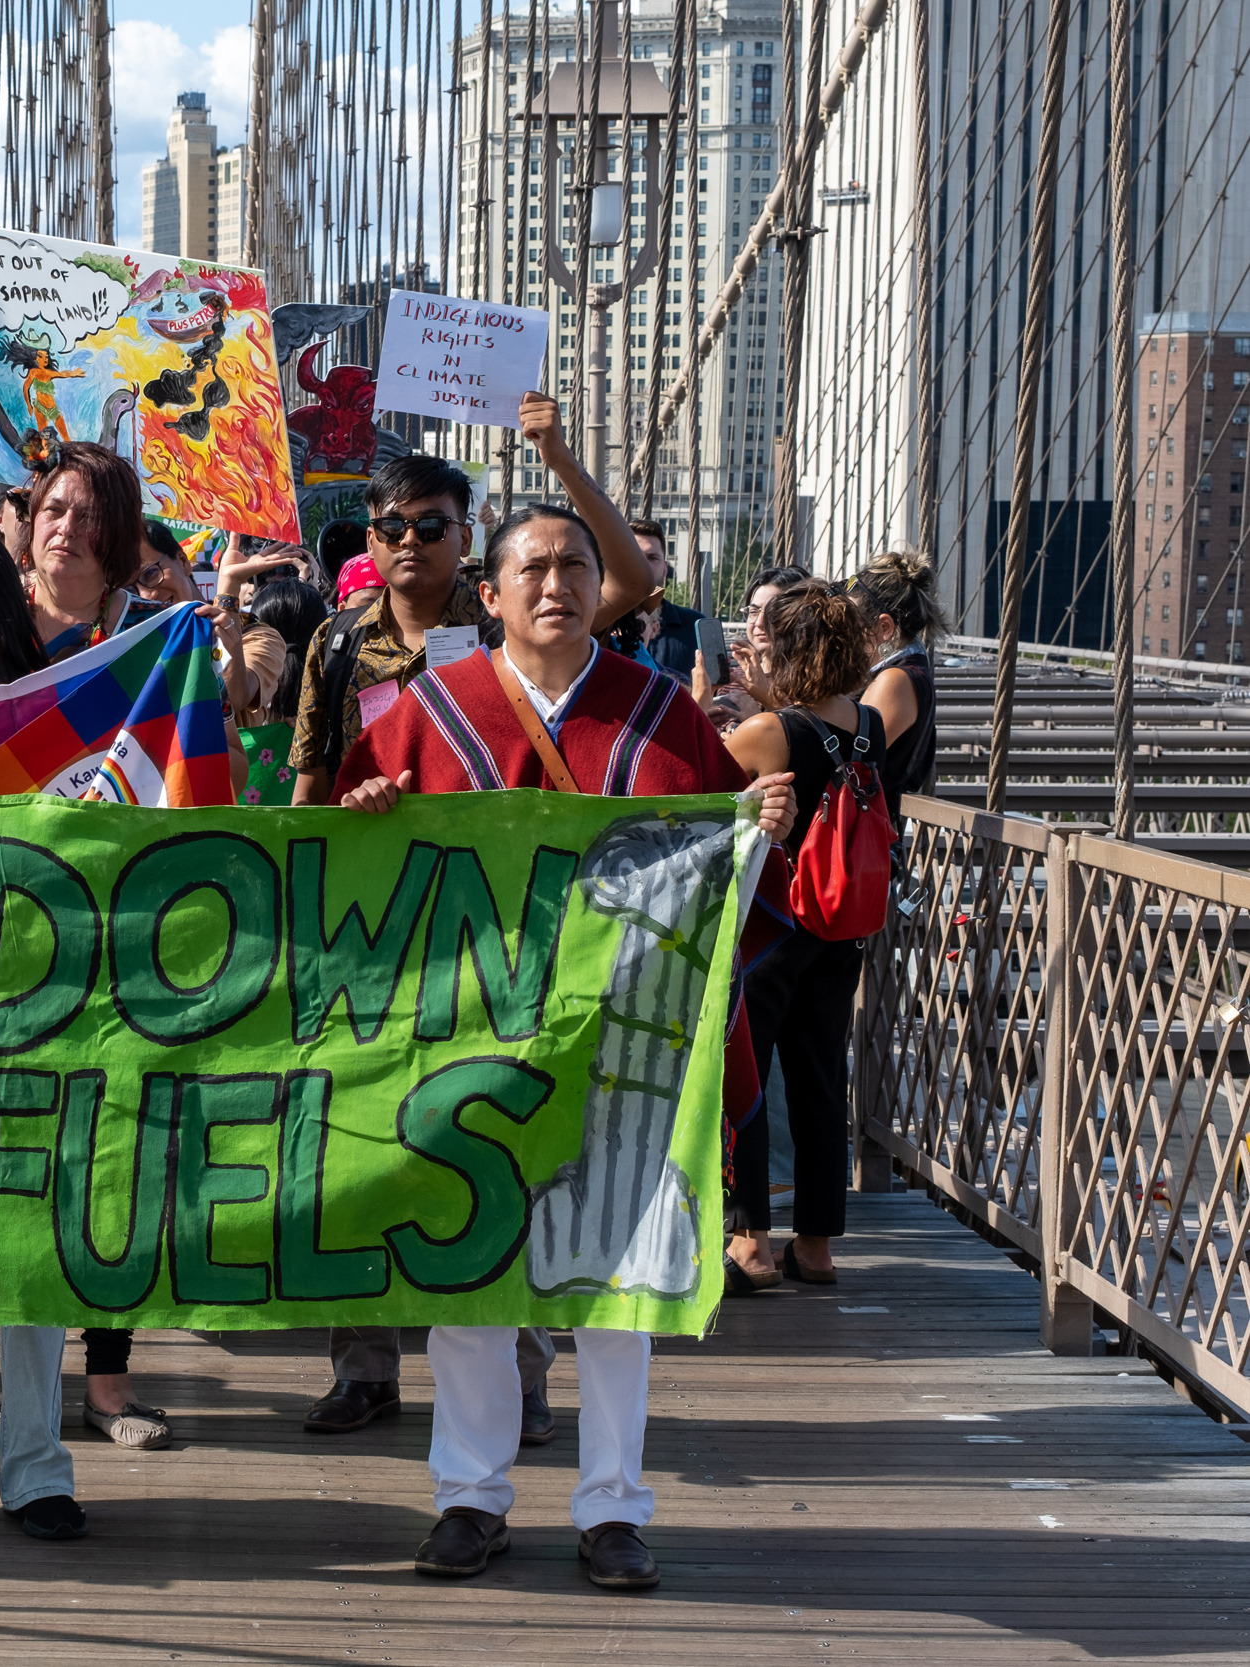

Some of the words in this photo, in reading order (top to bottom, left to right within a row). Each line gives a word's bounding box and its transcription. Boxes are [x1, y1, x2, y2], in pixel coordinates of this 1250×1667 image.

[12, 255, 43, 270] OUT
[50, 268, 69, 283] OF
[400, 298, 525, 333] INDIGENOUS
[169, 319, 188, 331] PLUS
[422, 327, 495, 350] RIGHTS
[442, 354, 461, 367] IN
